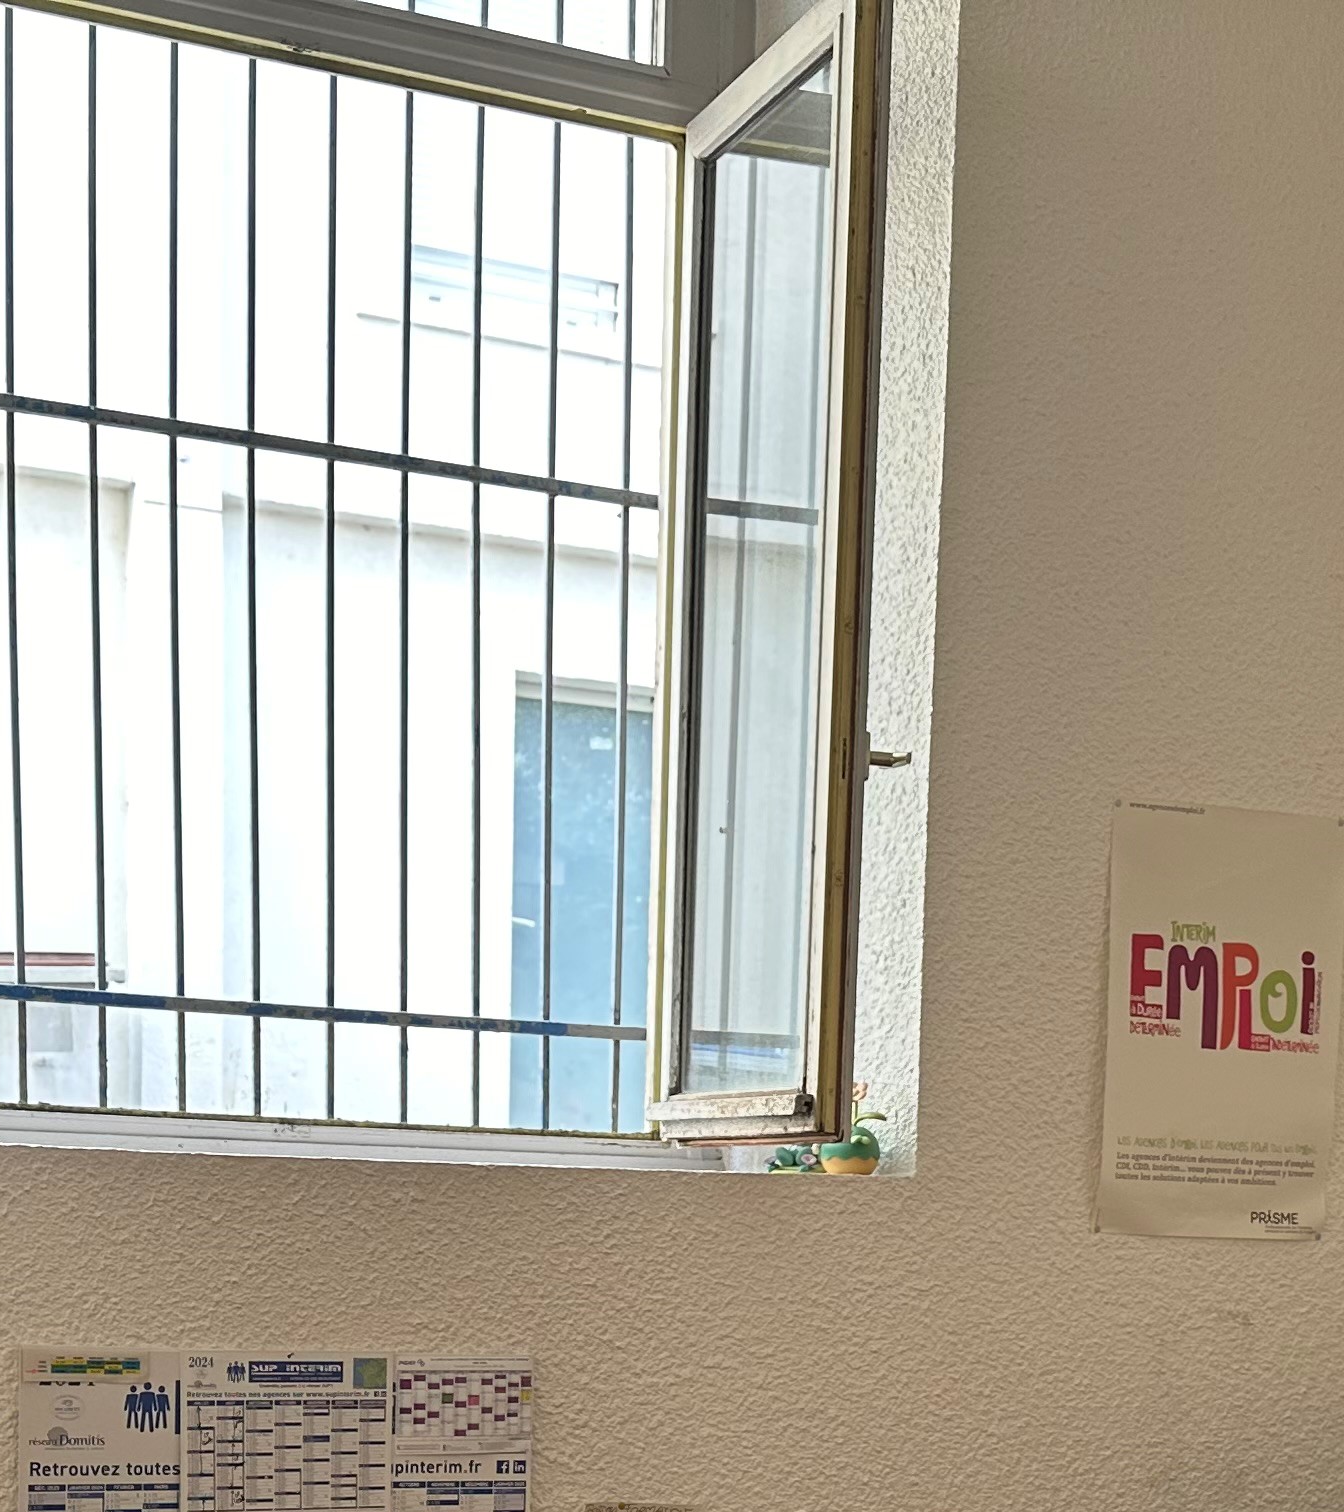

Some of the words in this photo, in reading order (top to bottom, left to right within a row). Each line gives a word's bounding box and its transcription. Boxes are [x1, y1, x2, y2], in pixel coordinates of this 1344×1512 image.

[1117, 1152, 1130, 1160] Les
[1131, 1154, 1160, 1162] agences
[1198, 1155, 1240, 1165] deviennent
[1241, 1157, 1253, 1165] des
[1255, 1160, 1283, 1168] agences
[1115, 1172, 1139, 1180] toutes
[1140, 1172, 1151, 1180] les
[1152, 1173, 1186, 1182] solutions
[1206, 1167, 1232, 1175] pouvez
[1253, 1168, 1281, 1177] présent
[1287, 1170, 1314, 1178] trouver
[188, 1356, 214, 1368] 2024
[251, 1364, 277, 1373] SUP
[187, 1391, 224, 1399] Retrouvez
[262, 1392, 291, 1400] agences
[29, 1462, 121, 1478] Retrouvez
[126, 1462, 181, 1476] toutes
